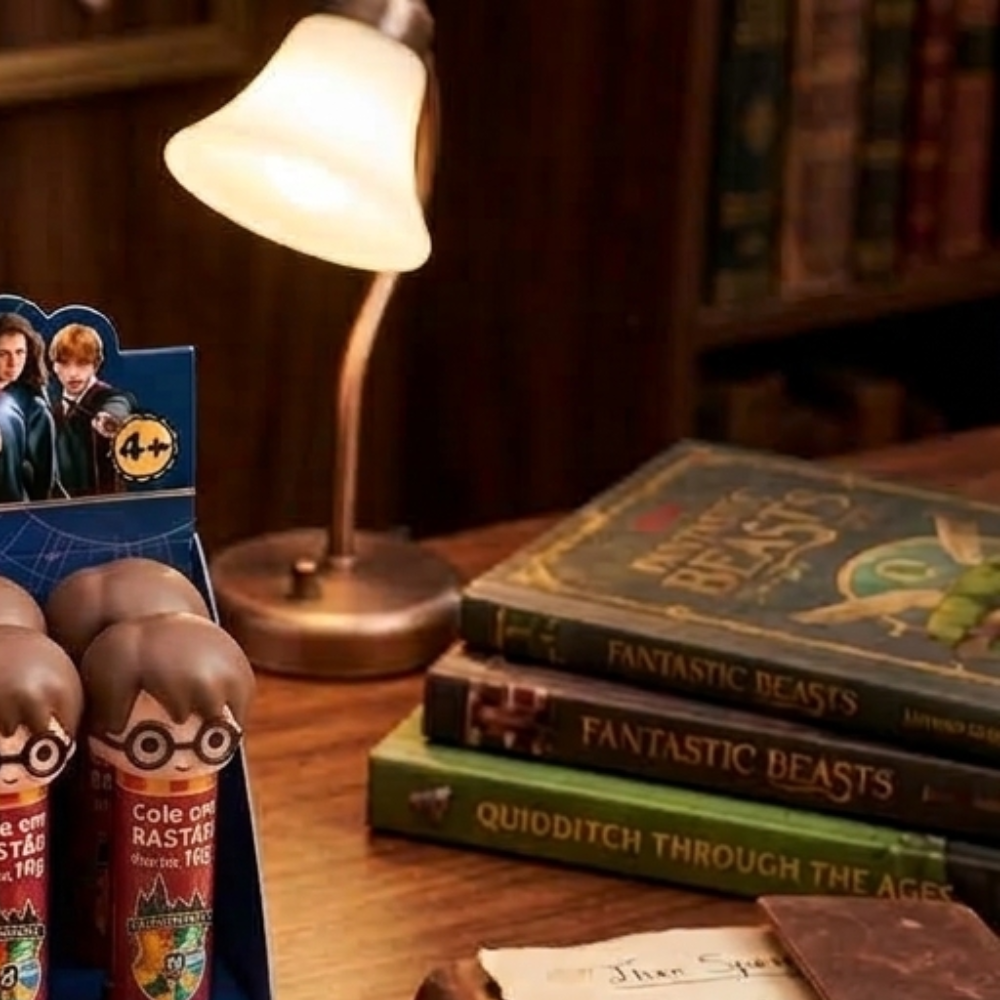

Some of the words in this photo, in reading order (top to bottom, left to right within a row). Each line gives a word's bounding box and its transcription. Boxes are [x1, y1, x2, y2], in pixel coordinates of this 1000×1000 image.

[119, 430, 171, 462] 4+
[607, 639, 749, 693] FANTASTIC
[754, 670, 860, 718] BEASTS
[580, 716, 757, 776] FANTASTIC
[766, 748, 896, 804] BEASTS
[651, 831, 800, 881] THROUGH
[809, 860, 869, 895] THE
